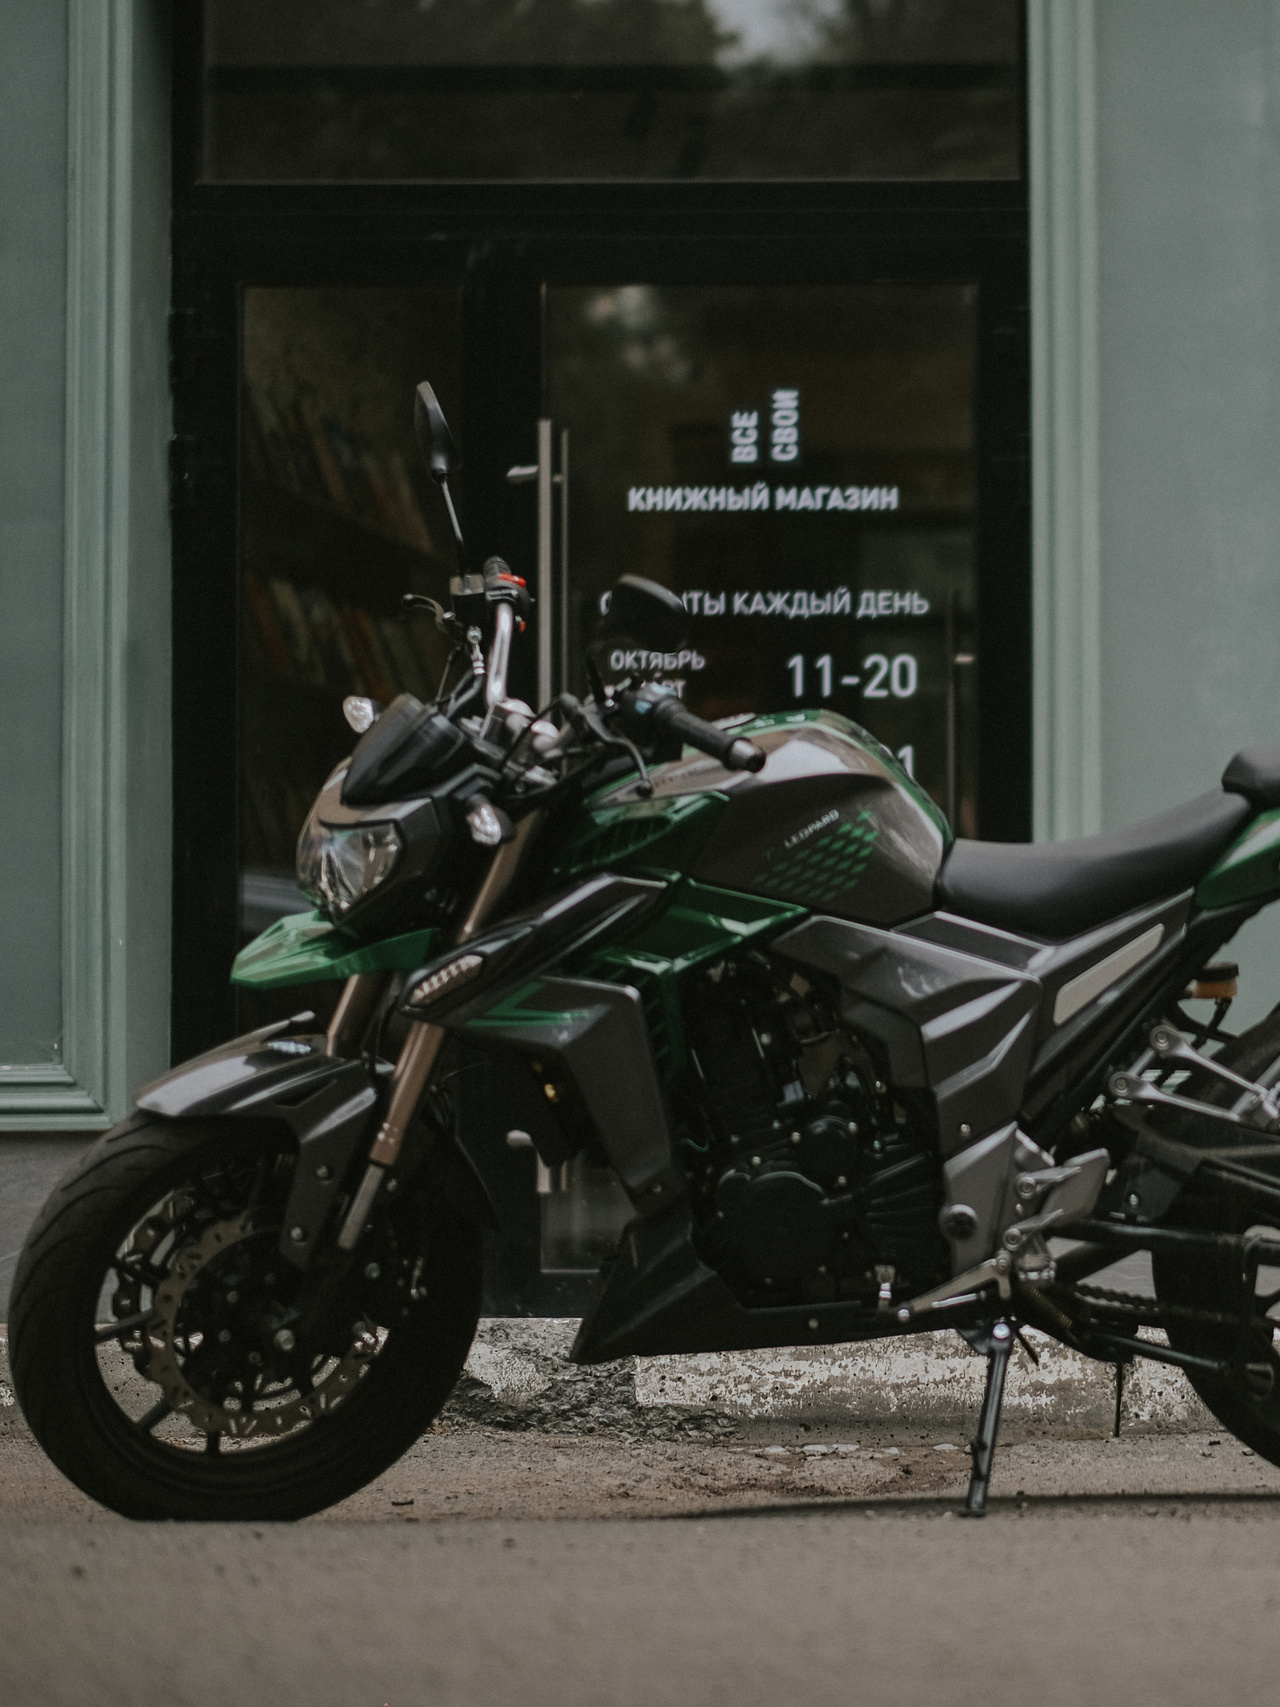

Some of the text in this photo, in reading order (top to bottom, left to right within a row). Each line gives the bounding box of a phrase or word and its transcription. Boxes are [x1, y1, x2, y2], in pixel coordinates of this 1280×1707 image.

[731, 410, 759, 463] ВСЕ
[771, 389, 799, 462] СВОИ
[627, 482, 899, 512] КНИЖНЫЙ МАГАЗИН
[733, 587, 851, 619] КАЖДЫЙ
[856, 590, 930, 619] ДЕНЬ
[610, 649, 706, 671] ОКТЯБРЬ
[787, 653, 918, 699] 11-20
[783, 809, 840, 849] LEOPARD
